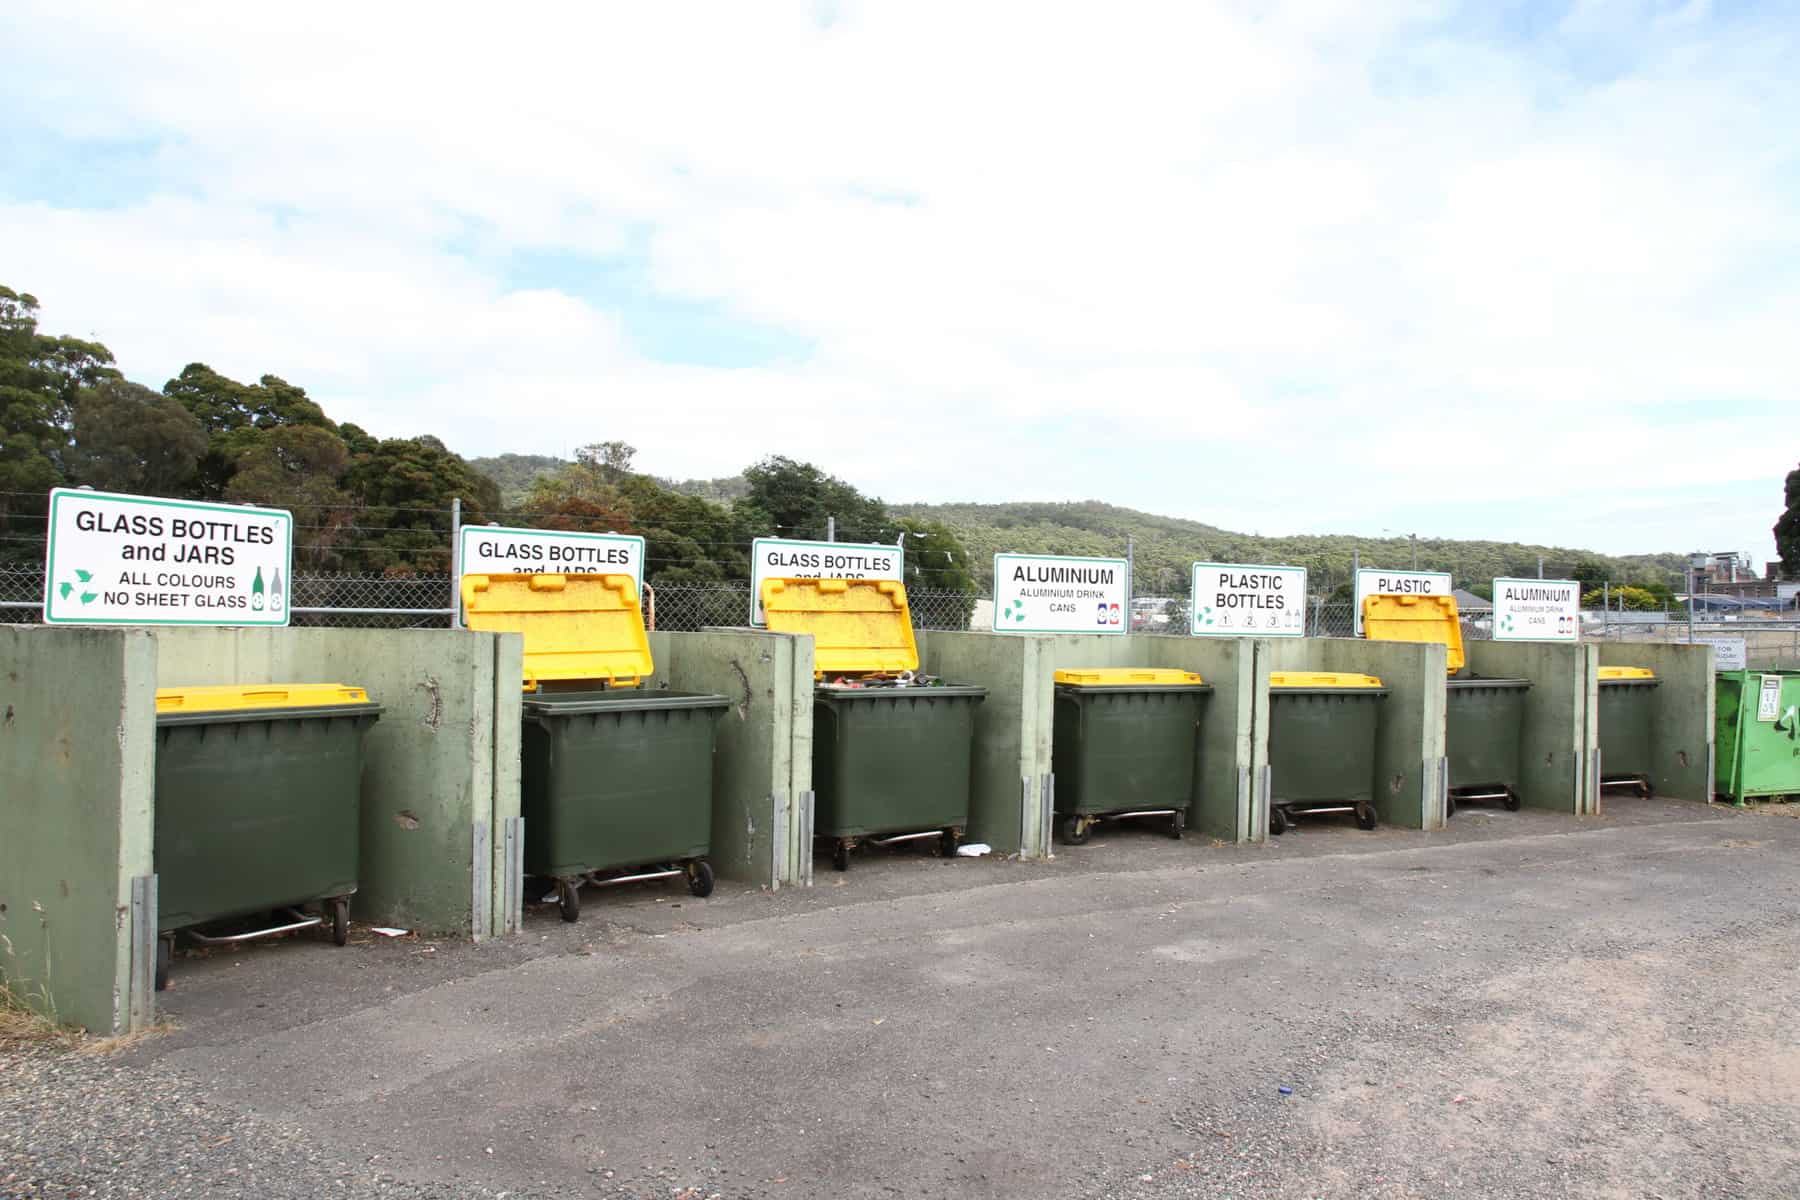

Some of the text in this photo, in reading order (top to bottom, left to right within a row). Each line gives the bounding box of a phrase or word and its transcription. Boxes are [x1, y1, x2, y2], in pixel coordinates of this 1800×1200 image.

[76, 510, 273, 545] GLASS BOTTLES
[122, 543, 235, 565] and JARS
[479, 542, 629, 564] GLASS BOTTLES
[768, 552, 891, 571] GLASS BOTTLES
[119, 571, 235, 588] ALL COLOURS
[1013, 565, 1114, 584] ALUMINIUM
[1219, 574, 1283, 590] PLASTIC
[1020, 588, 1105, 599] ALUMINIUM DRINK
[1378, 579, 1431, 593] PLASTIC
[104, 592, 247, 608] NO SHEET GLASS
[1216, 593, 1284, 609] BOTTLES
[1505, 587, 1570, 602] ALUMINIUM
[1049, 603, 1076, 613] CANS
